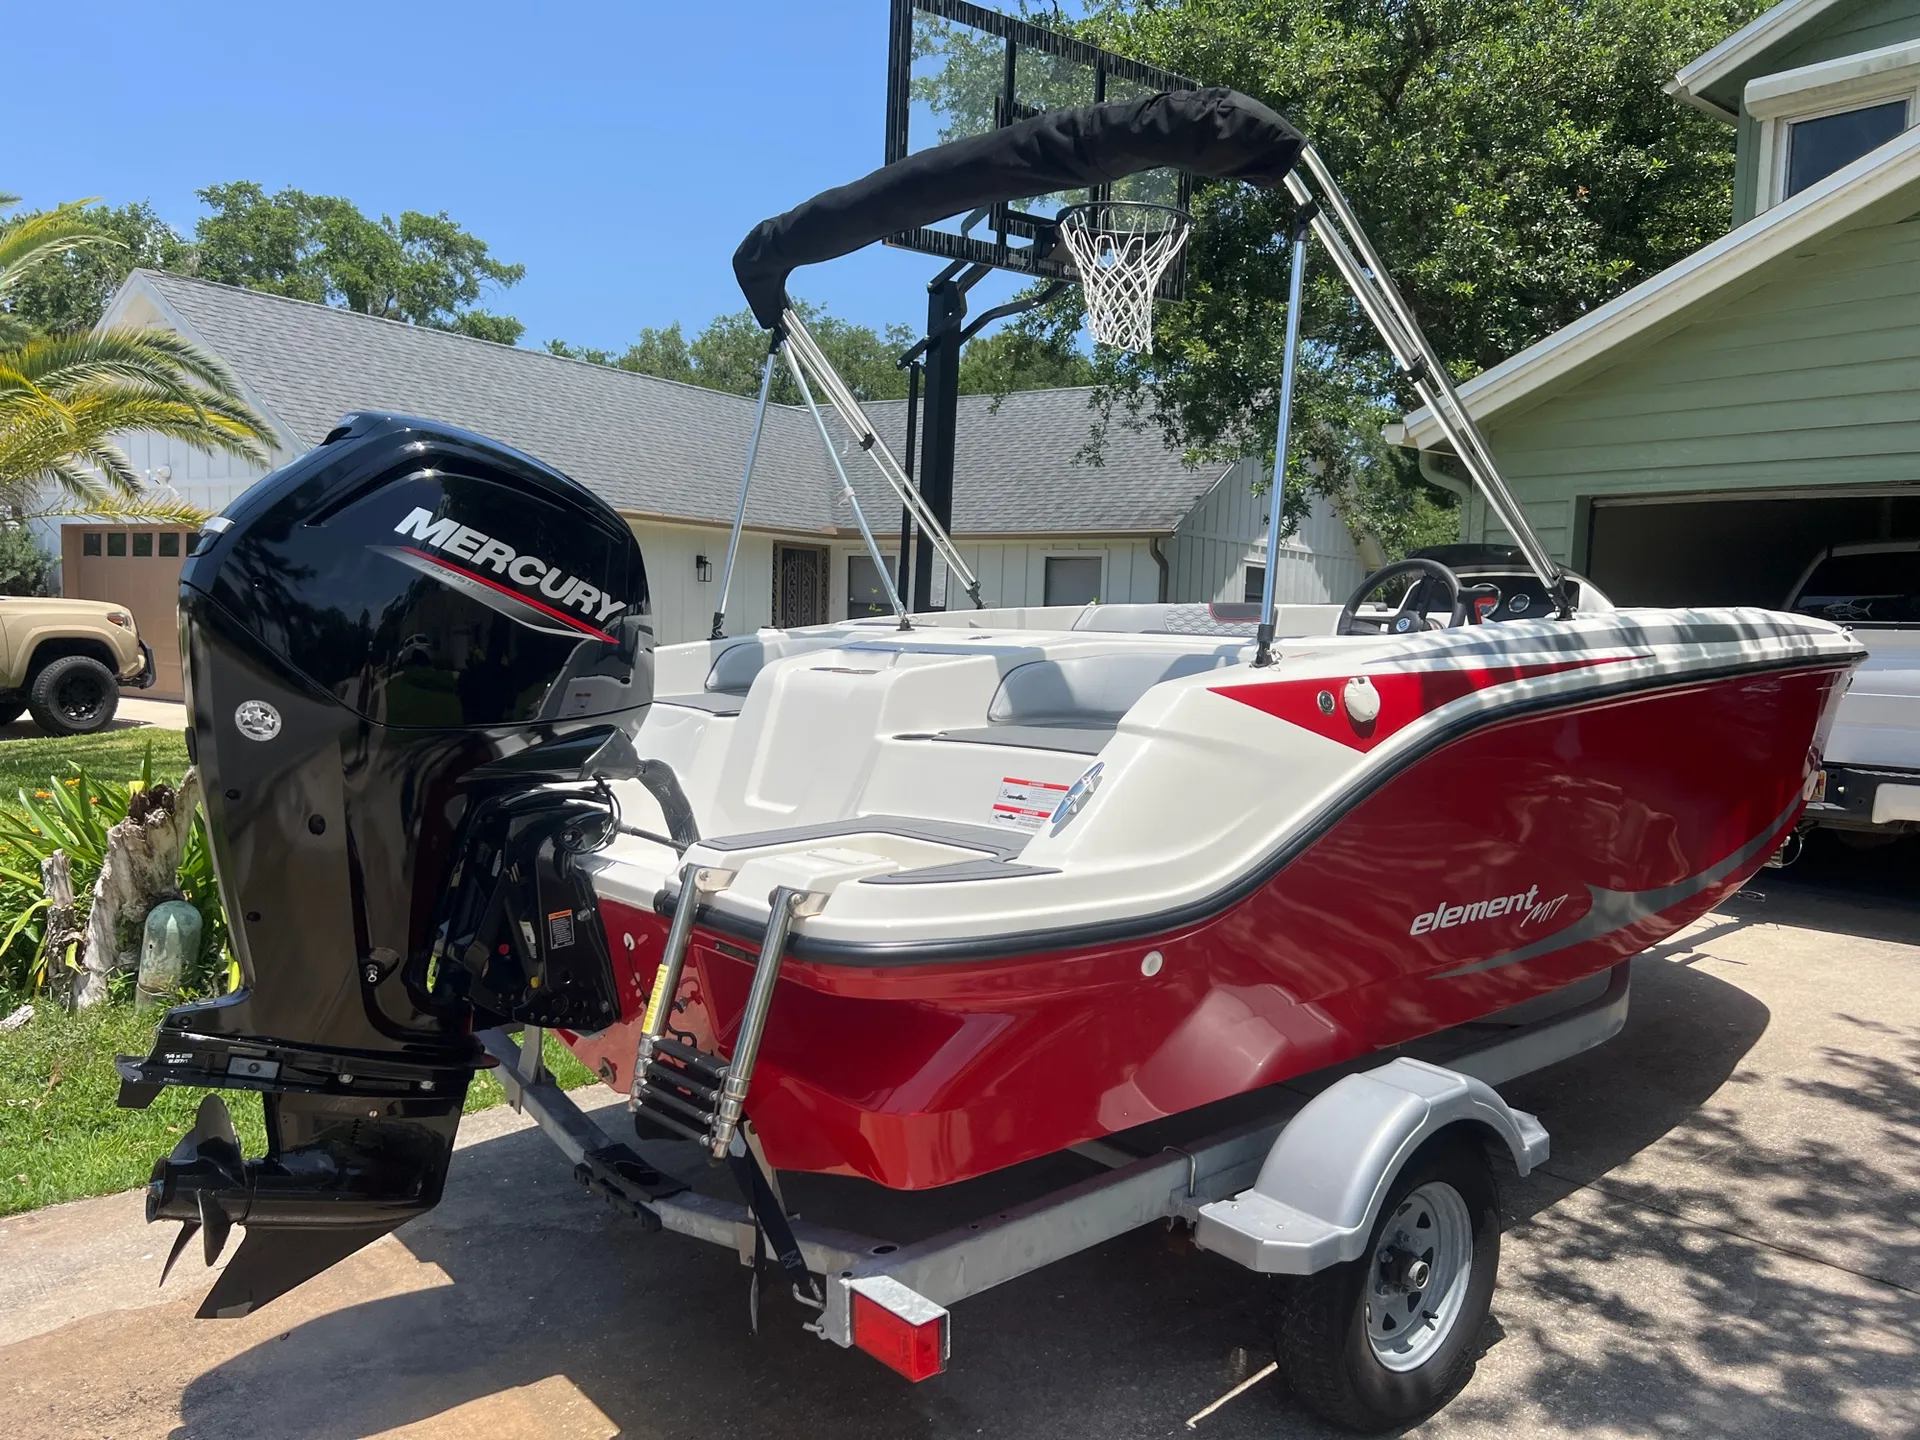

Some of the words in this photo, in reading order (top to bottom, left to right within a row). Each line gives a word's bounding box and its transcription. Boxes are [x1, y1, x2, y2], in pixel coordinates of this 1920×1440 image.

[394, 506, 627, 622] MERCURY
[1410, 884, 1539, 936] element
[1520, 893, 1568, 928] M17
